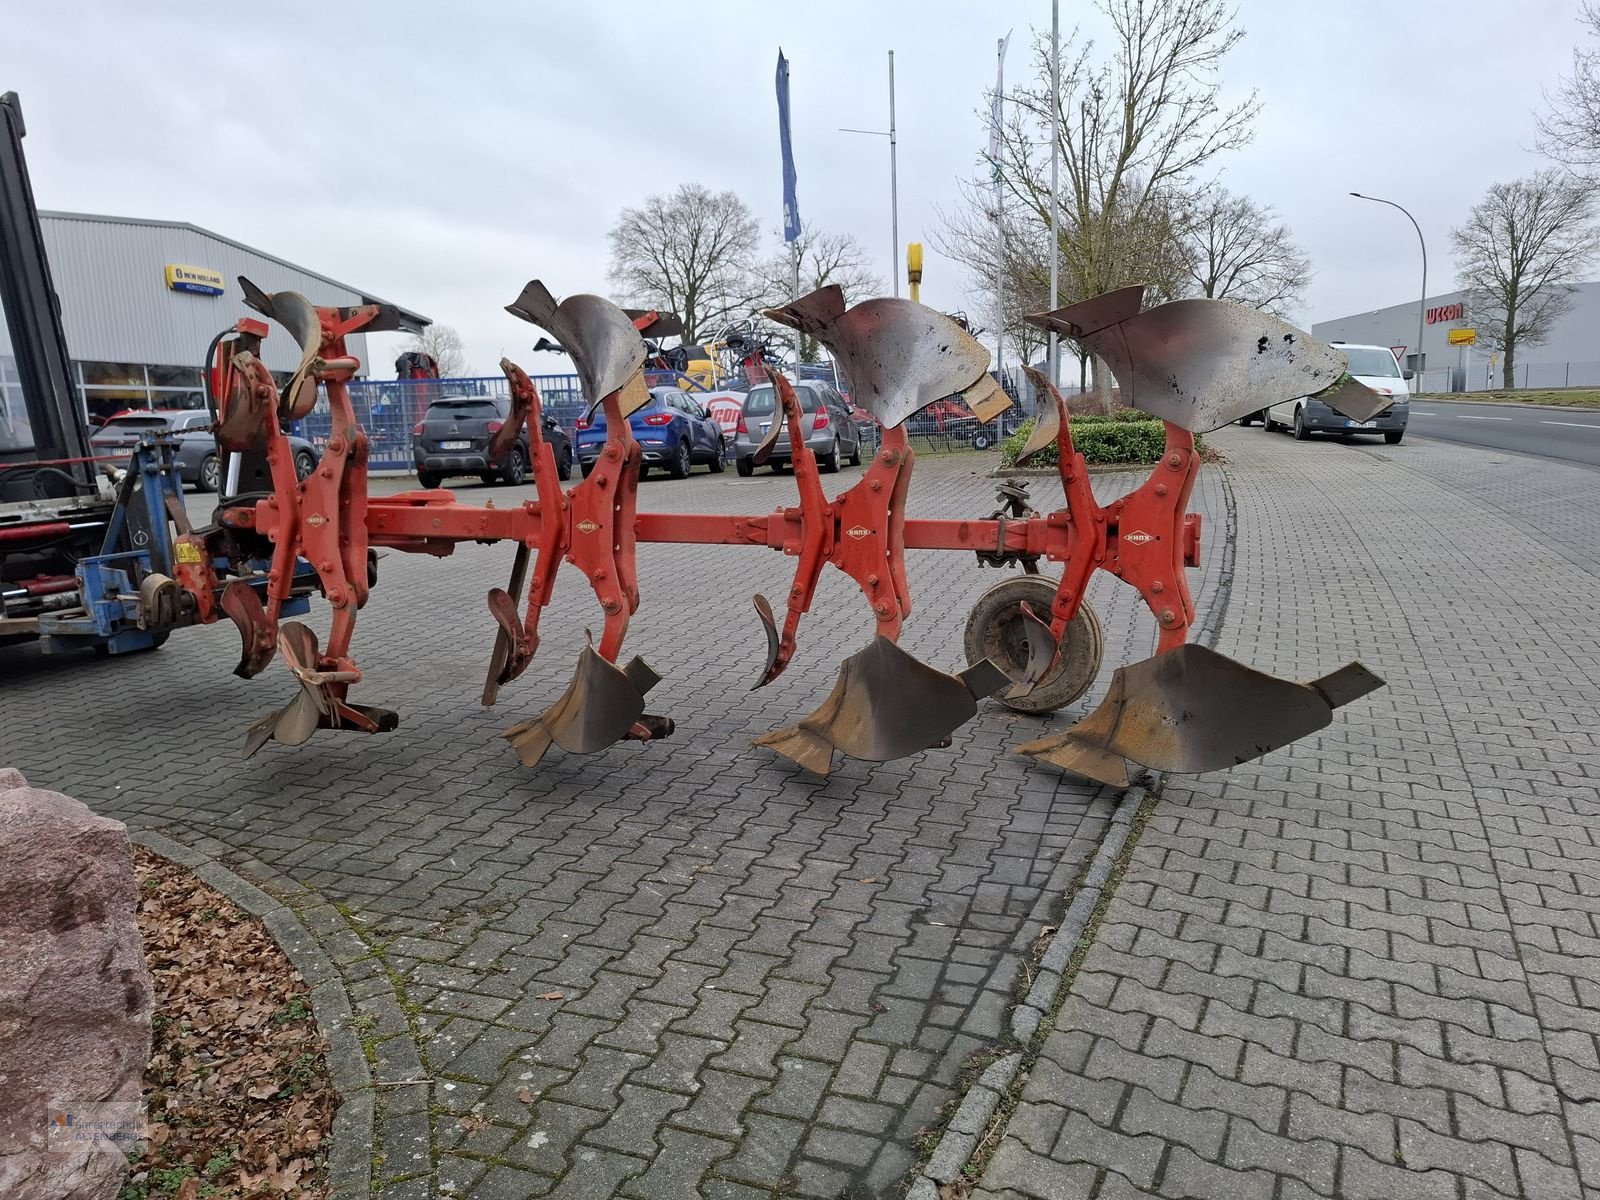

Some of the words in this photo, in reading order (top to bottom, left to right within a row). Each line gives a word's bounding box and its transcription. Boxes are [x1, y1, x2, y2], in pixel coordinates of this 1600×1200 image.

[183, 272, 196, 280] NEW
[196, 274, 220, 284] HOLLAND
[186, 283, 213, 292] AGRICULTURE
